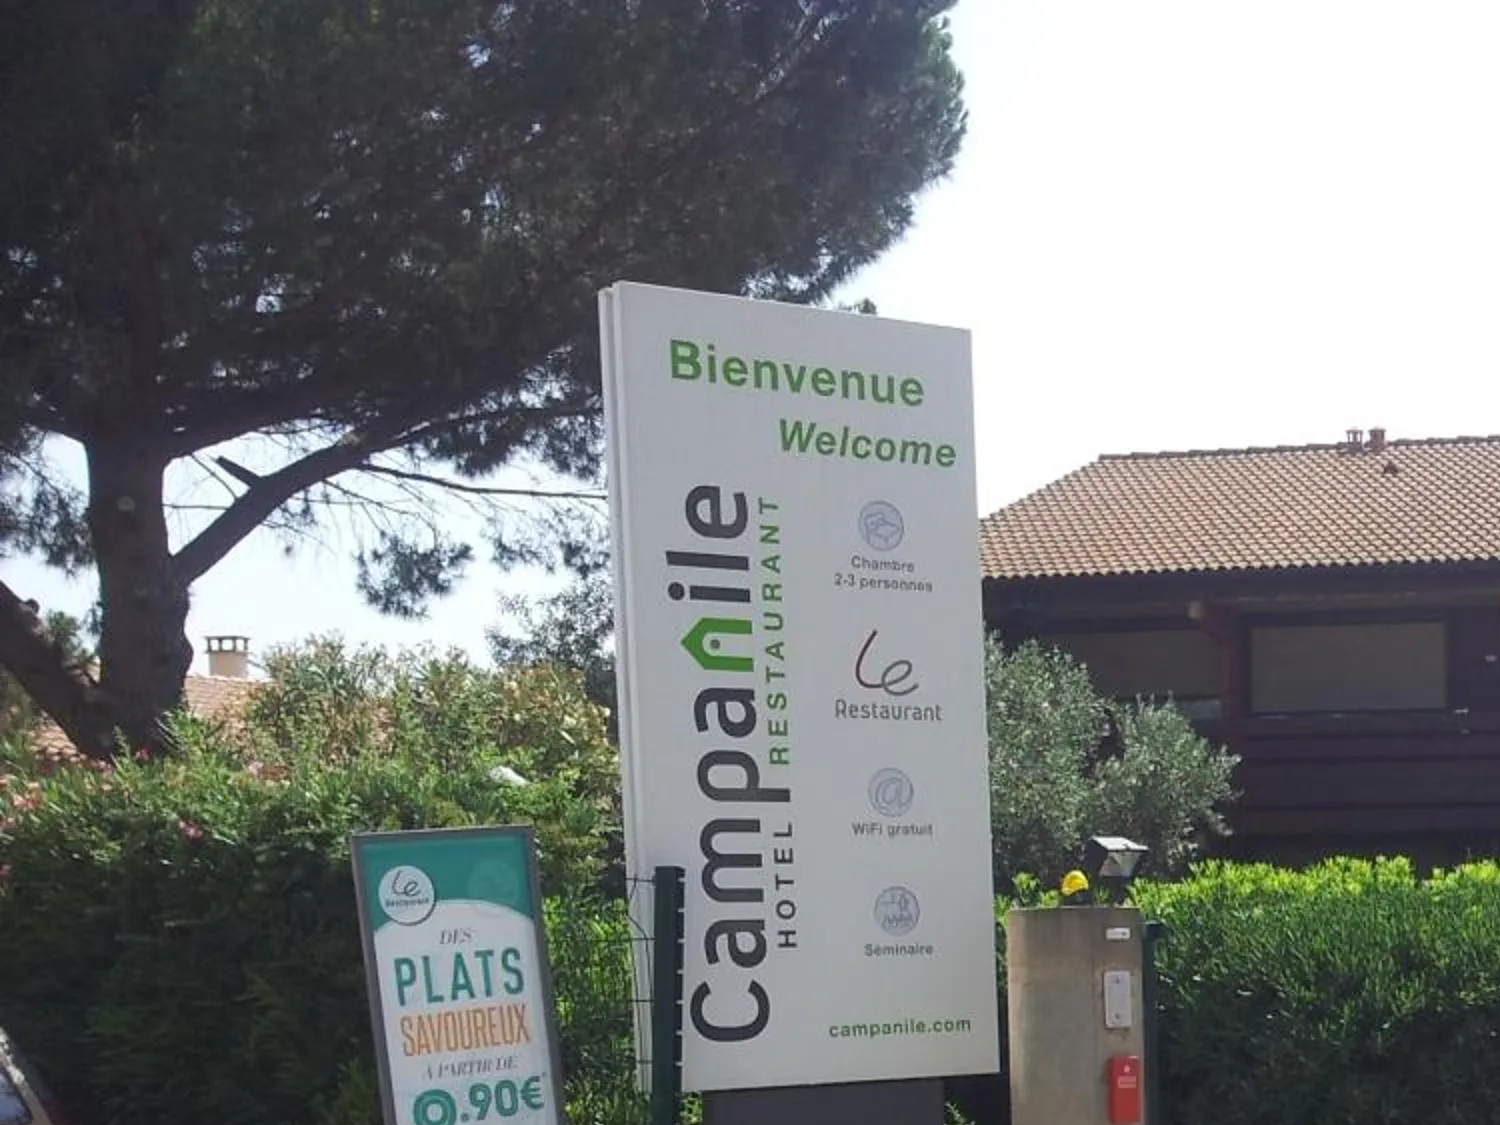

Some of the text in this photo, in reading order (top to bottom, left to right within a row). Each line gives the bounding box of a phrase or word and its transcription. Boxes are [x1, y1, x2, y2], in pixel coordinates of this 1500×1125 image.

[669, 338, 924, 407] Bienvenue
[779, 418, 957, 467] Welcome
[834, 573, 933, 594] 2-3 personnes
[850, 555, 916, 573] Chambre
[758, 497, 797, 949] HOTEL RESTAURANT
[834, 699, 942, 722] Restaurant
[666, 484, 790, 1042] Campanile
[851, 822, 934, 841] WiFi gratuit
[393, 947, 525, 1006] PLATS
[400, 1003, 530, 1057] SAVOUREUX
[829, 1017, 972, 1043] campanile.com
